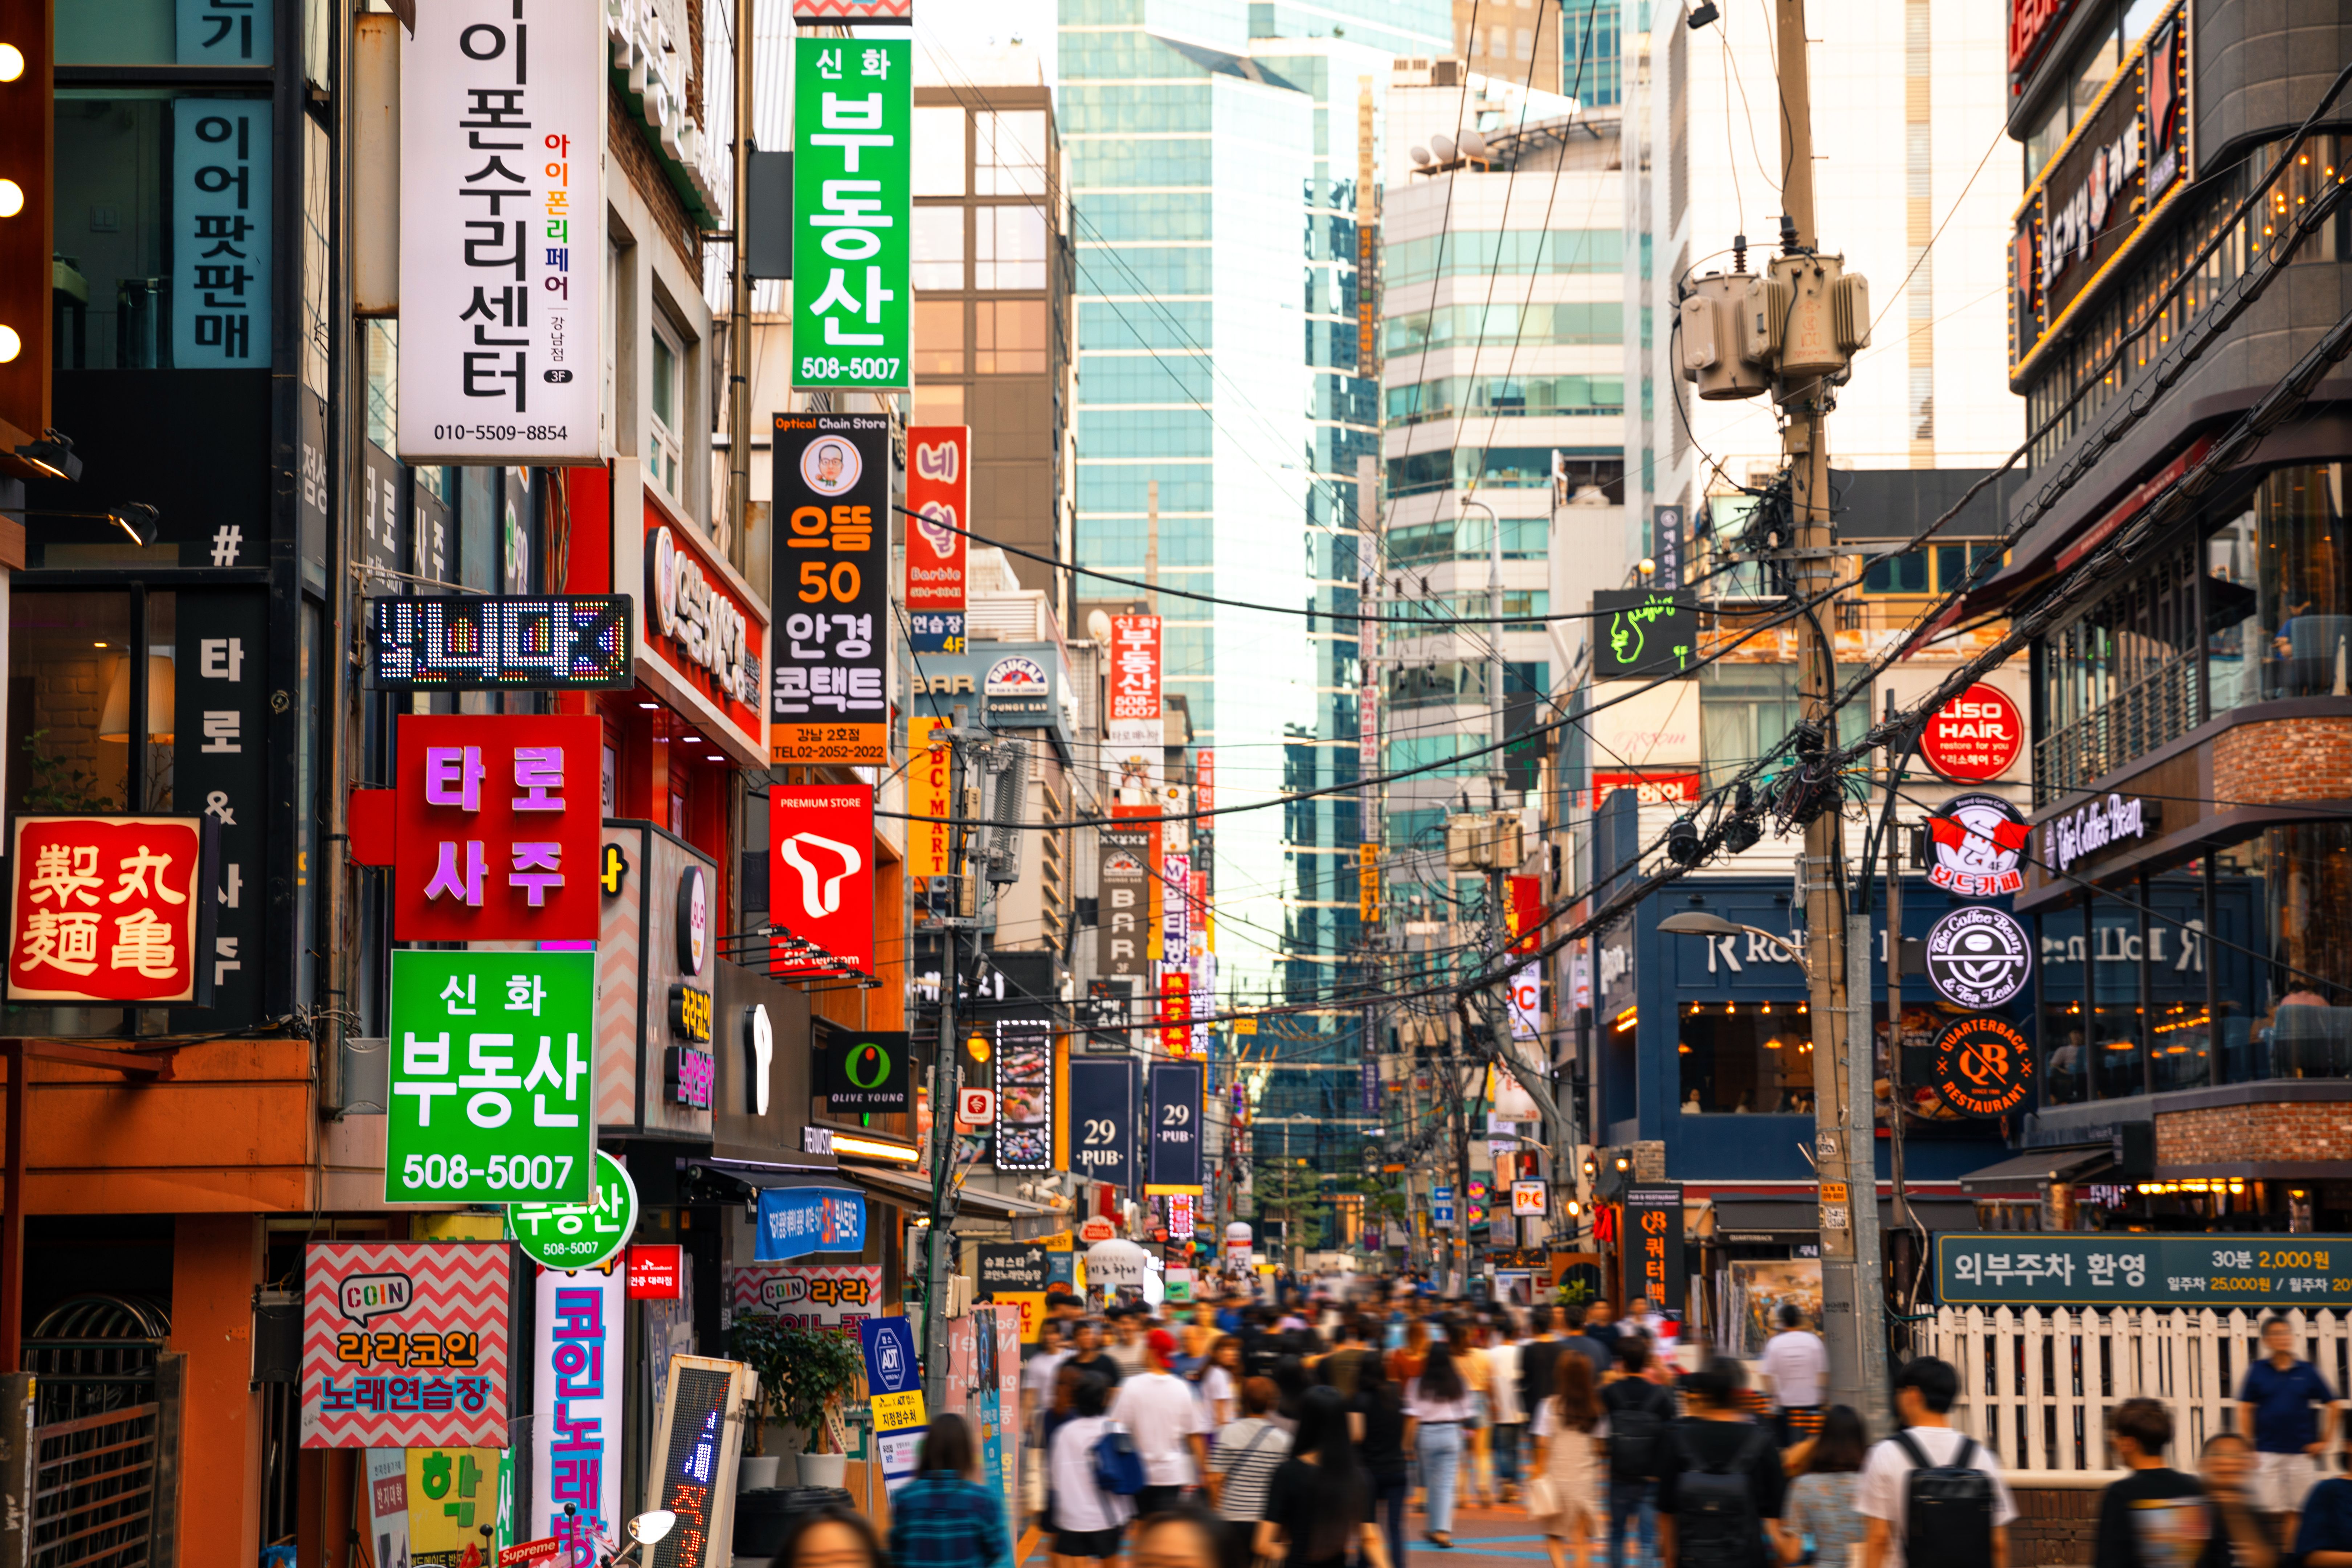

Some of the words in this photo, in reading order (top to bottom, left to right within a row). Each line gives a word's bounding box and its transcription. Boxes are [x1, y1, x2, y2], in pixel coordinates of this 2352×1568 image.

[459, 0, 531, 412] 이폰수리센터
[544, 134, 571, 301] 아이폰리페어
[809, 91, 894, 346] 부동산
[550, 316, 565, 362] 강남점
[551, 370, 566, 382] 3F
[801, 357, 899, 379] 508-5007
[434, 425, 568, 441] 010-5509-8854
[776, 418, 816, 431] Optical
[819, 418, 850, 429] Chain
[853, 418, 886, 429] Store
[787, 506, 873, 552] 으뜸
[799, 562, 861, 604] 50
[911, 567, 961, 581] Barbie
[786, 613, 872, 659] 안경
[912, 616, 964, 634] 연습장
[943, 636, 964, 653] 4F
[989, 658, 1043, 684] BRUGAL
[1117, 629, 1157, 695] 부동산
[773, 666, 884, 714] 콘택트
[990, 703, 1025, 712] OUNGE
[1028, 703, 1048, 712] BAR
[1114, 706, 1157, 717] 5007
[797, 728, 823, 742] 강남
[828, 727, 859, 741] 2호점
[1940, 741, 1972, 750] restore
[1976, 741, 1989, 750] for
[1992, 742, 2009, 751] you
[1993, 755, 2005, 765] 5F
[781, 798, 828, 808] PREMIUM
[830, 798, 861, 807] STORE
[2057, 815, 2076, 871] The
[2076, 801, 2110, 857] Coffee
[2107, 793, 2144, 841] Bean
[1987, 861, 2002, 871] 4F
[1928, 864, 2024, 895] 보드카페
[1931, 929, 1952, 953] The
[1948, 909, 1993, 931] Coffee
[1994, 914, 2022, 954] Bean
[784, 951, 806, 966] SK
[1942, 978, 1956, 992] &
[1956, 984, 1980, 1003] Tea
[1981, 973, 2016, 1002] Leaf
[682, 986, 711, 1043] 라라코인
[1940, 1018, 2029, 1055] QUARTERBACK
[394, 1032, 587, 1128] 부동산
[832, 1093, 863, 1103] OLIVE
[867, 1093, 904, 1102] YOUNG
[1942, 1080, 2026, 1113] RESTAURANT
[1162, 1104, 1190, 1126] 29
[1083, 1119, 1116, 1145] 29
[403, 1154, 573, 1190] 508-5007
[1515, 1190, 1543, 1208] PC
[543, 1242, 598, 1255] 508-5007
[2212, 1251, 2253, 1269] 30분
[2259, 1250, 2330, 1270] 2,000원
[984, 1256, 1025, 1268] 슈퍼스타
[1955, 1252, 2075, 1287] 외부주차
[2087, 1253, 2146, 1288] 환영
[648, 1276, 672, 1286] 대리점
[765, 1281, 802, 1299] COIN
[811, 1279, 870, 1306] 라라
[2168, 1277, 2205, 1292] 일주차
[2210, 1277, 2271, 1293] 25,000원
[2289, 1277, 2328, 1292] 월주차
[2332, 1277, 2352, 1292] 20
[347, 1282, 404, 1308] COIN
[337, 1332, 478, 1368] 라라코인
[882, 1347, 899, 1371] ADT
[321, 1376, 492, 1414] 노래연습장
[883, 1409, 917, 1426] 지정접수처
[377, 1482, 402, 1510] 반지대학
[502, 1540, 556, 1563] Supreme
